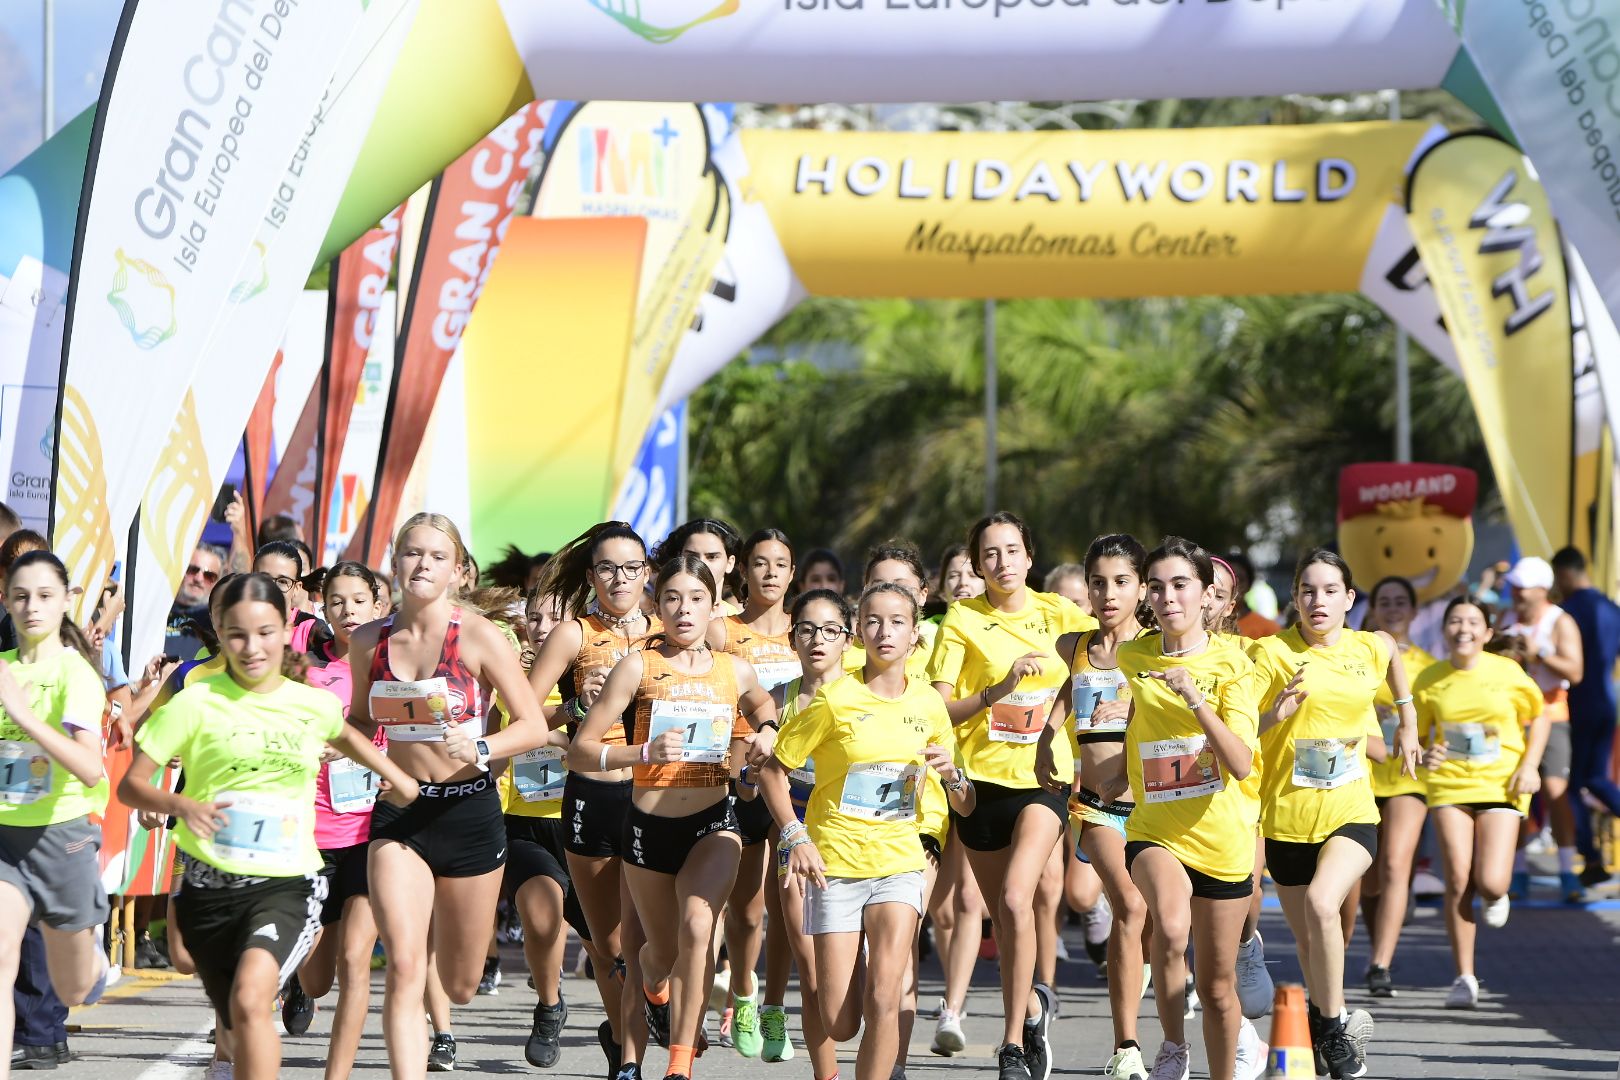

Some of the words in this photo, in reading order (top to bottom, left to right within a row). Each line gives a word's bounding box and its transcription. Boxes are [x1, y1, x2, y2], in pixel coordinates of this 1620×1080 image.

[173, 219, 207, 273] Isla
[193, 95, 253, 218] Europea
[244, 38, 273, 91] del
[260, 0, 299, 40] De
[134, 108, 211, 240] Gran
[795, 154, 1358, 203] HOLIDAYWORLD
[264, 181, 296, 230] Isla
[904, 221, 1120, 264] Maspalomas
[1129, 222, 1243, 259] Center
[1358, 473, 1457, 503] WOOLAND
[403, 701, 414, 719] 1
[1024, 709, 1034, 728] 1
[687, 722, 697, 743] 1
[4, 762, 14, 785] 1
[540, 764, 549, 784] 1
[1170, 759, 1181, 782] 1
[1328, 755, 1337, 775] 1
[363, 770, 372, 791] 1
[443, 778, 487, 798] PRO
[880, 782, 893, 803] 1
[253, 819, 265, 843] 1
